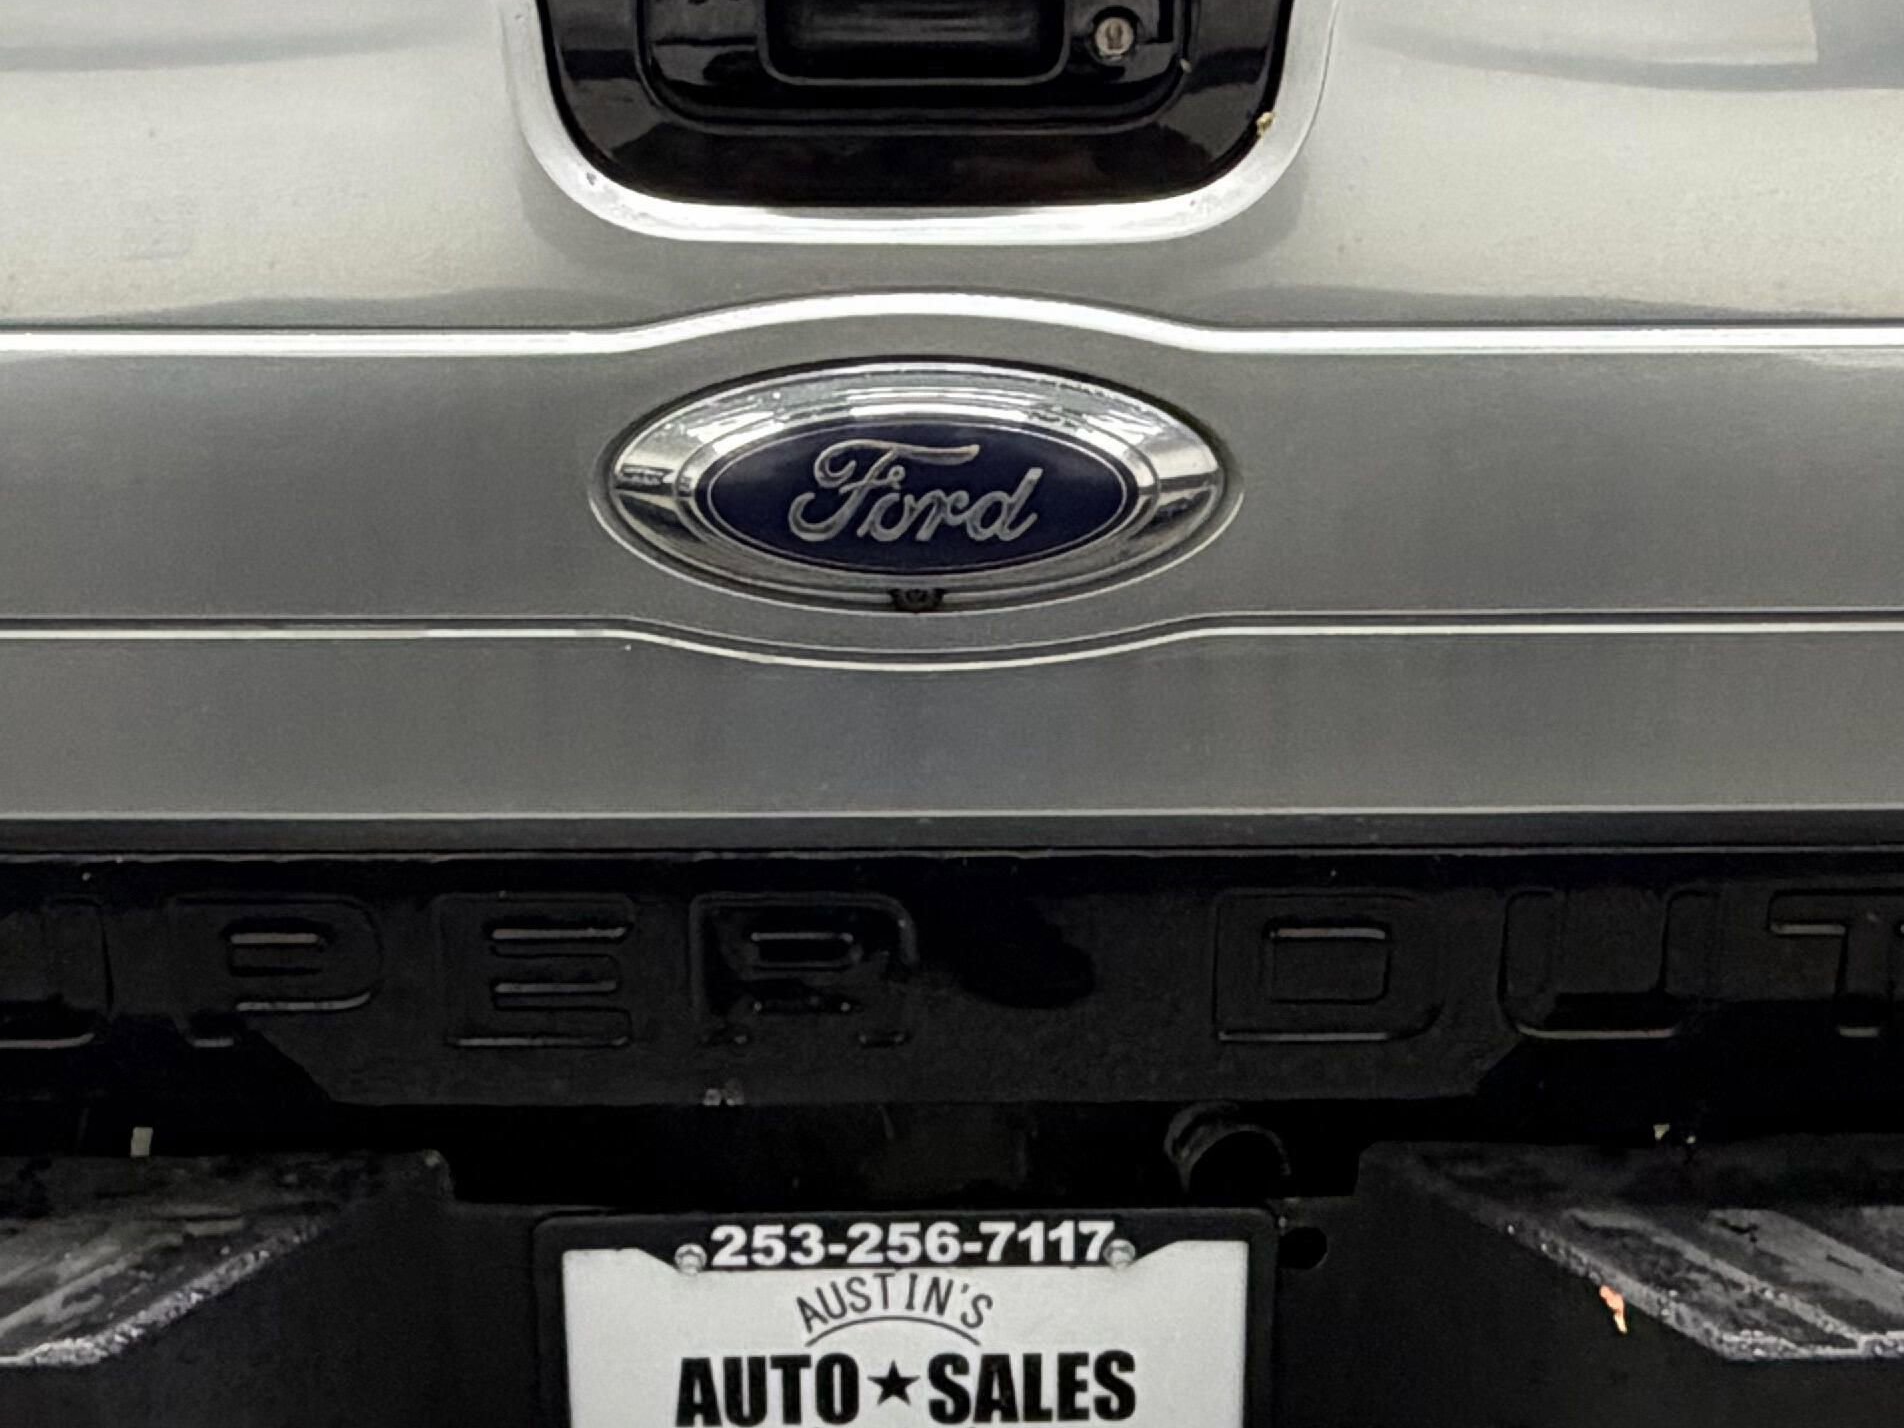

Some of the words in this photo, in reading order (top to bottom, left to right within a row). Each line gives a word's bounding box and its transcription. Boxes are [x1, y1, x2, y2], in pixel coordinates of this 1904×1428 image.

[788, 438, 1043, 544] Ford
[709, 1220, 1115, 1268] 253-256-7117
[795, 1272, 994, 1334] AUSTIN'S
[675, 1352, 860, 1427] AUTO
[927, 1349, 1137, 1425] SALES
